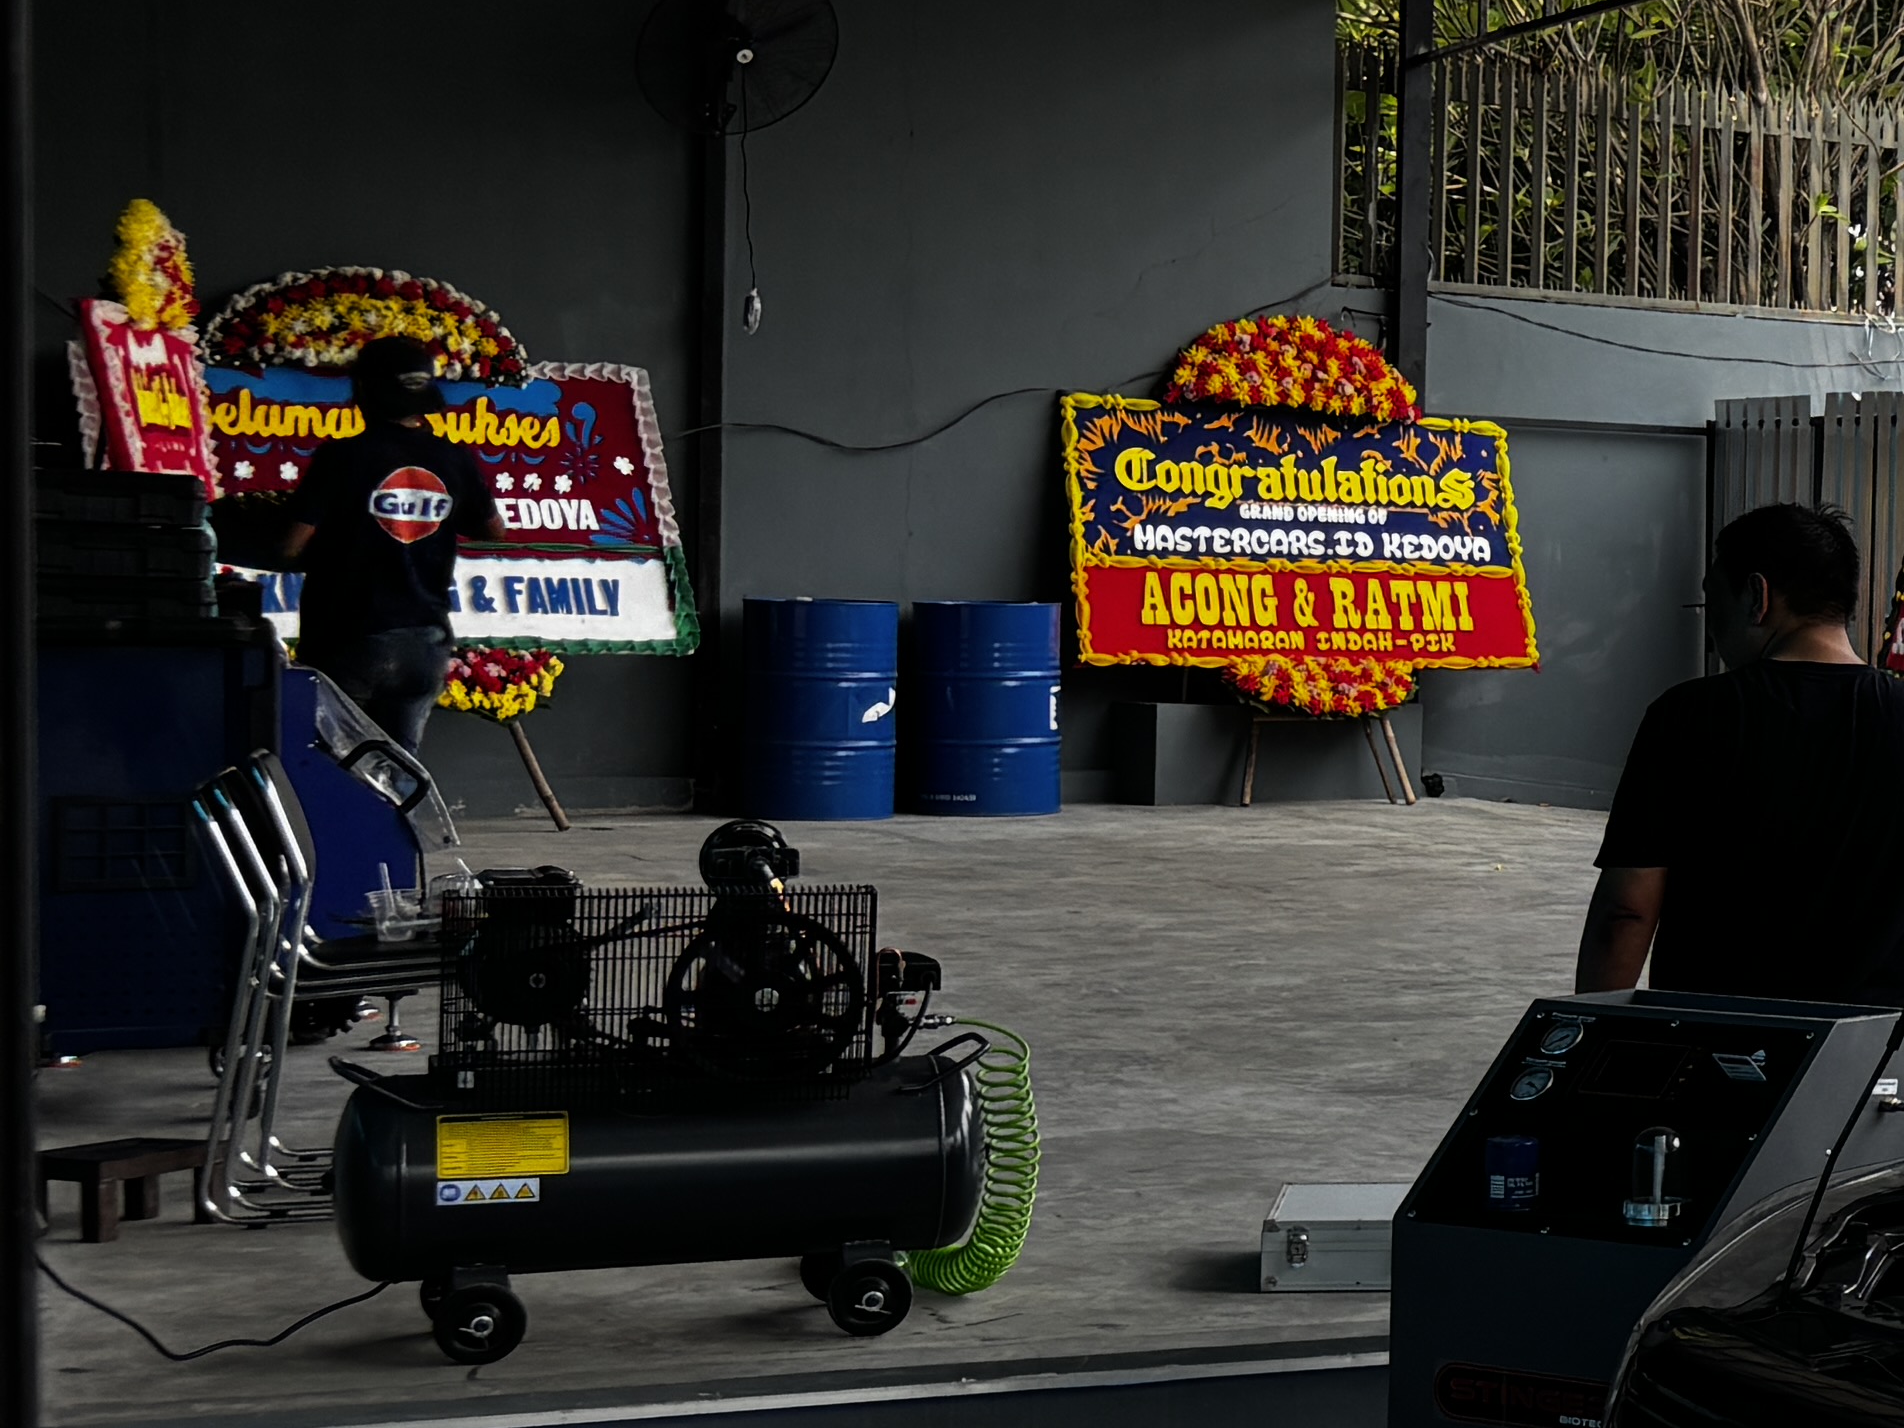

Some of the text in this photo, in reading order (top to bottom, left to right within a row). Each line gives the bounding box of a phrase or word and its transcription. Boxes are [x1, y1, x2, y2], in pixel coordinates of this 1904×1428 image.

[373, 491, 449, 520] Gulf
[1239, 503, 1293, 521] GRAND
[1297, 505, 1365, 524] OPENING
[1134, 525, 1491, 562] MASTERCARS.ID KEDOYA
[470, 575, 497, 613] &
[502, 576, 620, 617] FAMILY
[1141, 572, 1474, 632] ACONG & RATMI
[1167, 629, 1304, 651] KATAMARAN
